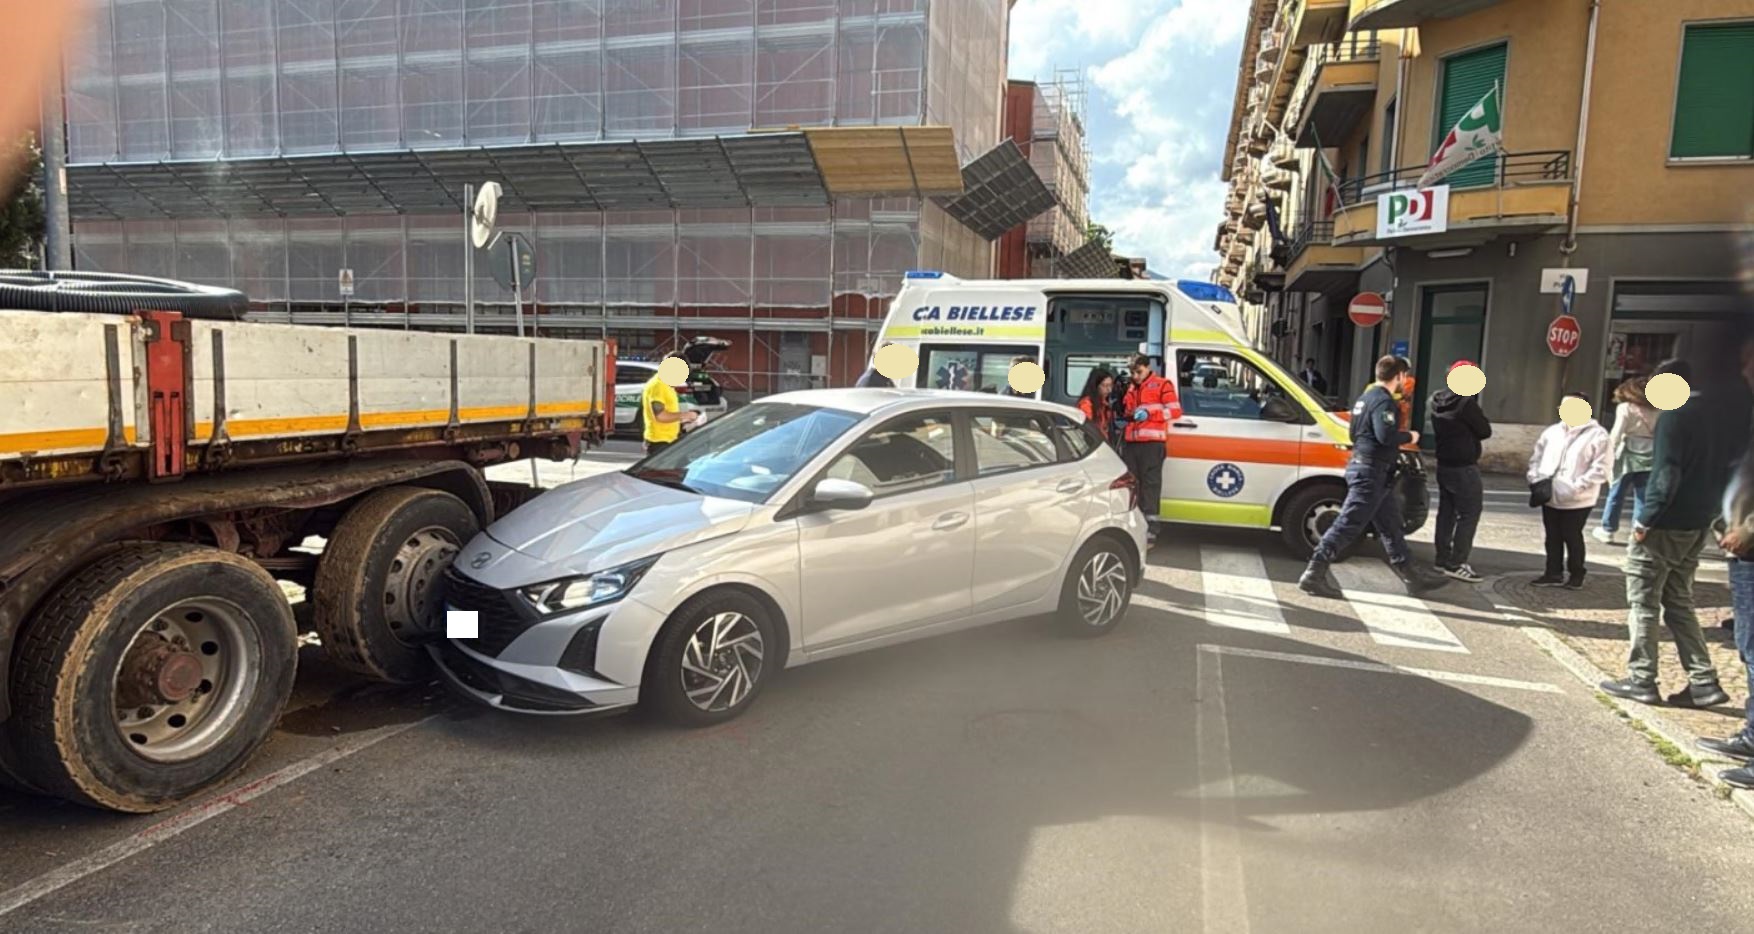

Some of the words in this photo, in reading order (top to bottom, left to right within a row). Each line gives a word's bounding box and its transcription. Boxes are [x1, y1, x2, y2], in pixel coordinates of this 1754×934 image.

[1388, 189, 1434, 225] PD
[912, 306, 941, 321] CA
[946, 306, 1036, 321] BIELLESE
[1550, 327, 1579, 345] STOP
